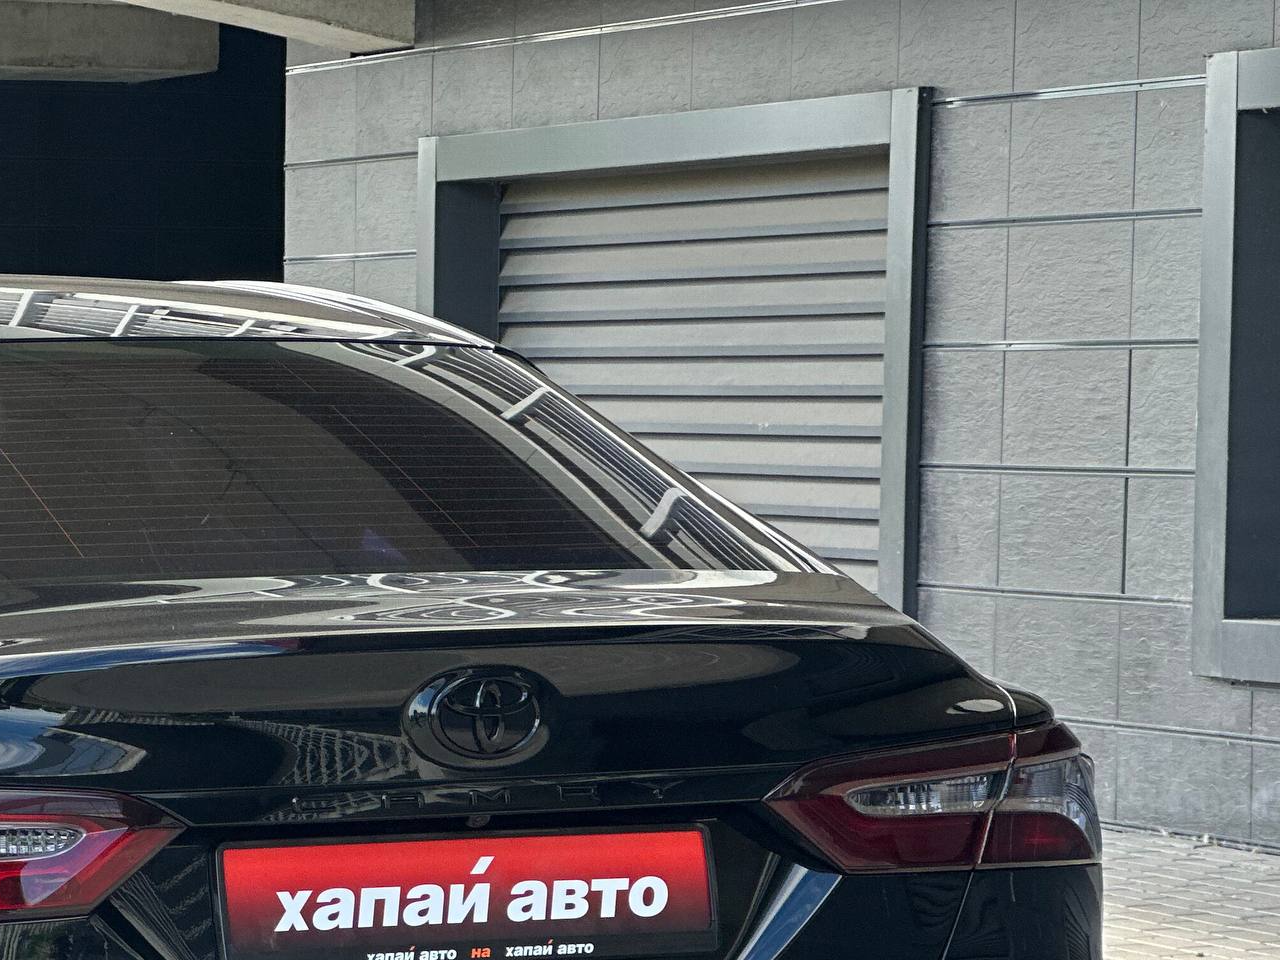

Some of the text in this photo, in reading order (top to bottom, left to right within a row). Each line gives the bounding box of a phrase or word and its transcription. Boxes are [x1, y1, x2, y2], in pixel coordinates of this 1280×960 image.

[274, 856, 669, 932] хапай авто
[470, 946, 491, 959] на
[557, 942, 594, 955] авто
